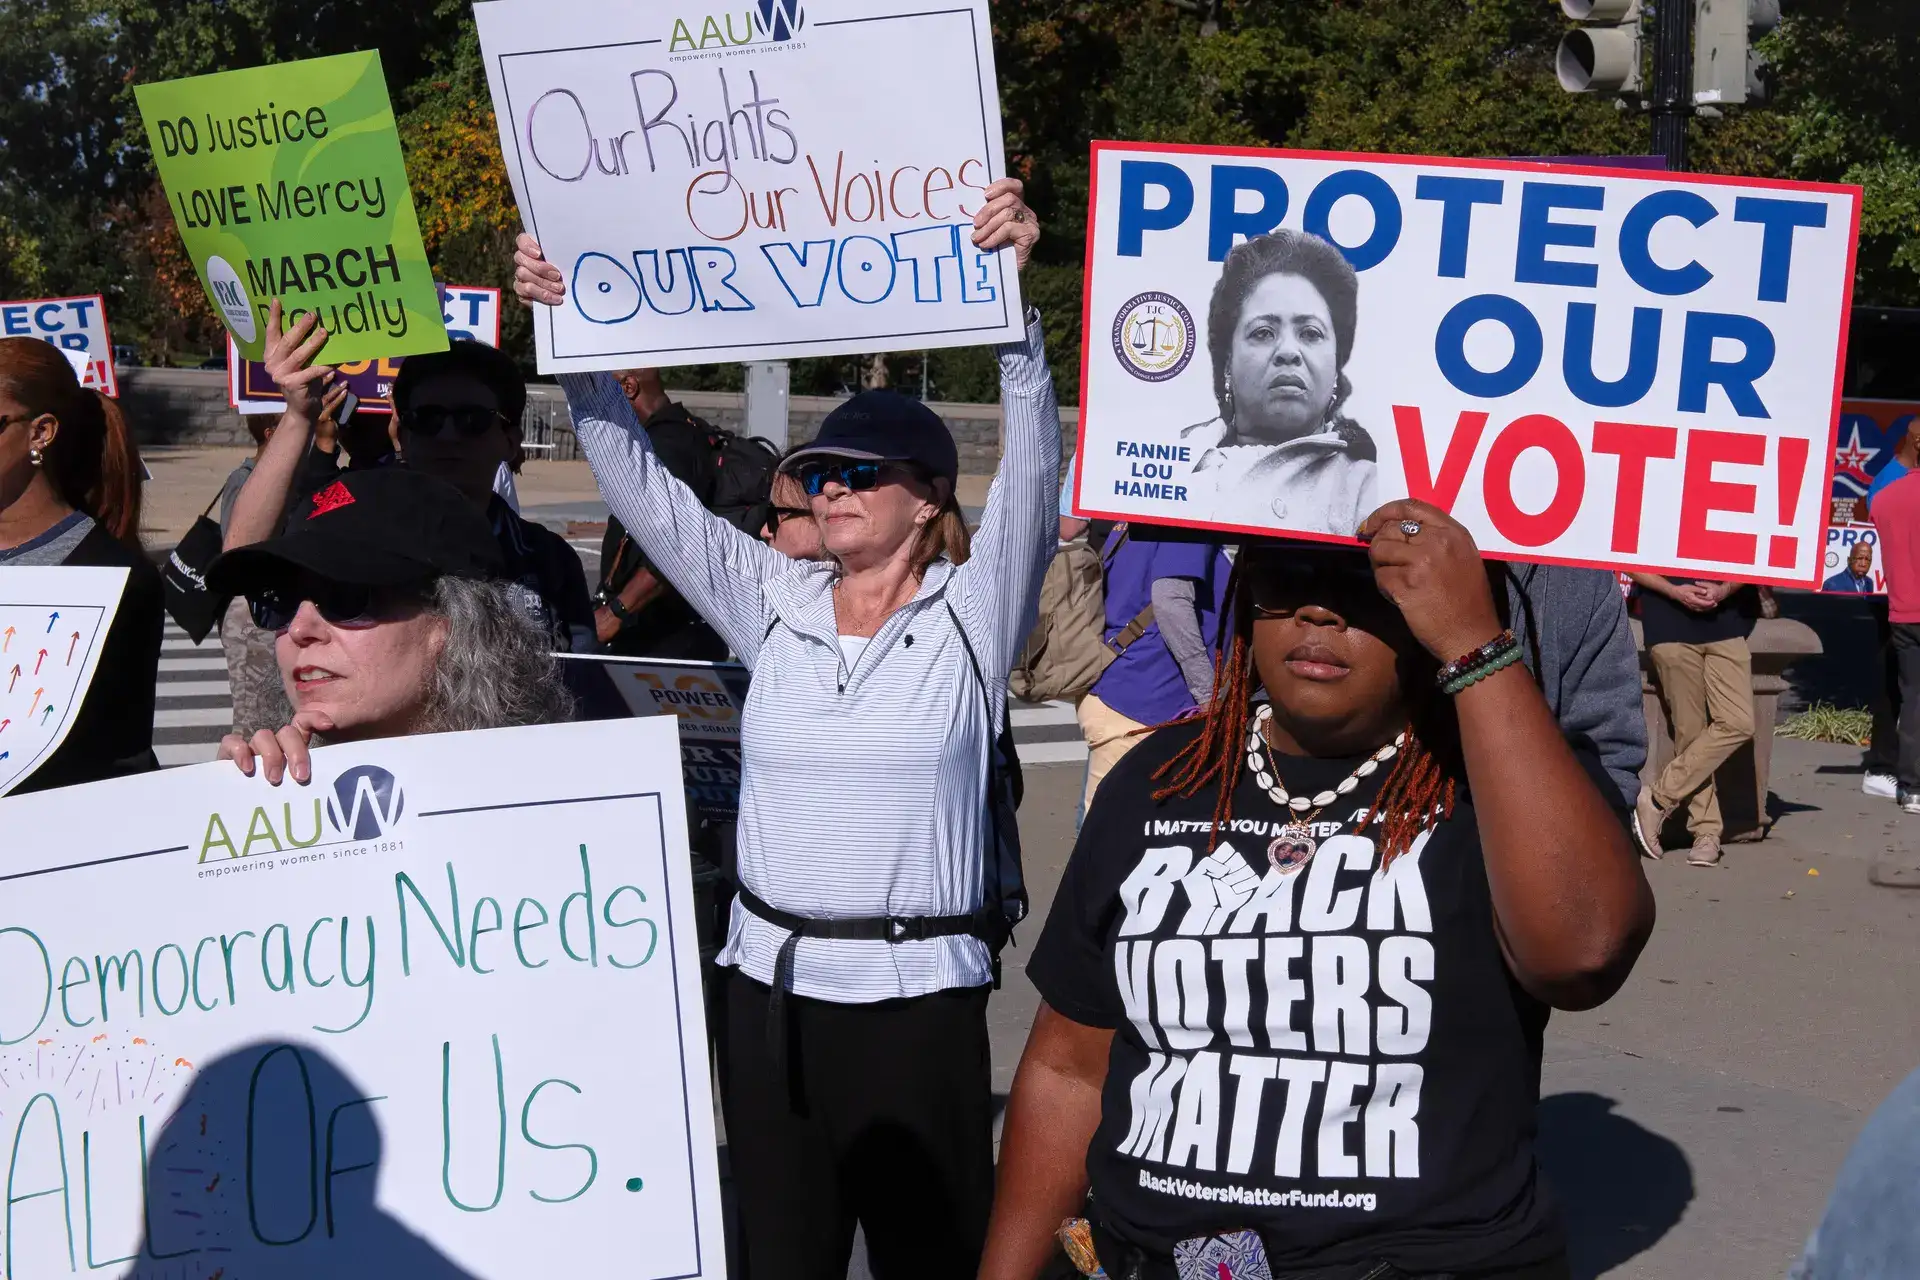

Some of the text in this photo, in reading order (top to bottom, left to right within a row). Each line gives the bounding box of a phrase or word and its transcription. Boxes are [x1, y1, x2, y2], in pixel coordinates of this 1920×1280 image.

[669, 0, 805, 52] AAUW
[669, 42, 807, 63] empowering women since 1881
[157, 102, 329, 158] DO Justice
[526, 67, 798, 195] Our Rights
[177, 177, 387, 228] LOVE Mercy
[686, 150, 992, 241] Our Voices
[1117, 160, 1827, 303] PROTECT
[245, 244, 402, 297] MARCH
[571, 223, 996, 325] OUR VOTE
[1145, 305, 1166, 315] TJC
[1154, 293, 1182, 311] JUSTICE
[1435, 293, 1776, 419] OUR
[1116, 441, 1191, 462] FANNIE
[1131, 462, 1173, 480] LOU
[1114, 480, 1188, 501] HAMER
[1391, 405, 1810, 569] VOTE!
[649, 688, 732, 709] POWER
[197, 764, 405, 864] AAUW
[1144, 820, 1151, 837] I
[1229, 819, 1269, 836] YOU
[198, 841, 405, 879] empowering women since 1881
[0, 842, 659, 1045] Democracy Needs
[1114, 936, 1436, 1056] VOTERS
[1116, 1050, 1425, 1179] MATTER
[5, 1092, 202, 1280] ALL
[1138, 1168, 1377, 1211] BlackVotersMatterFund.org
